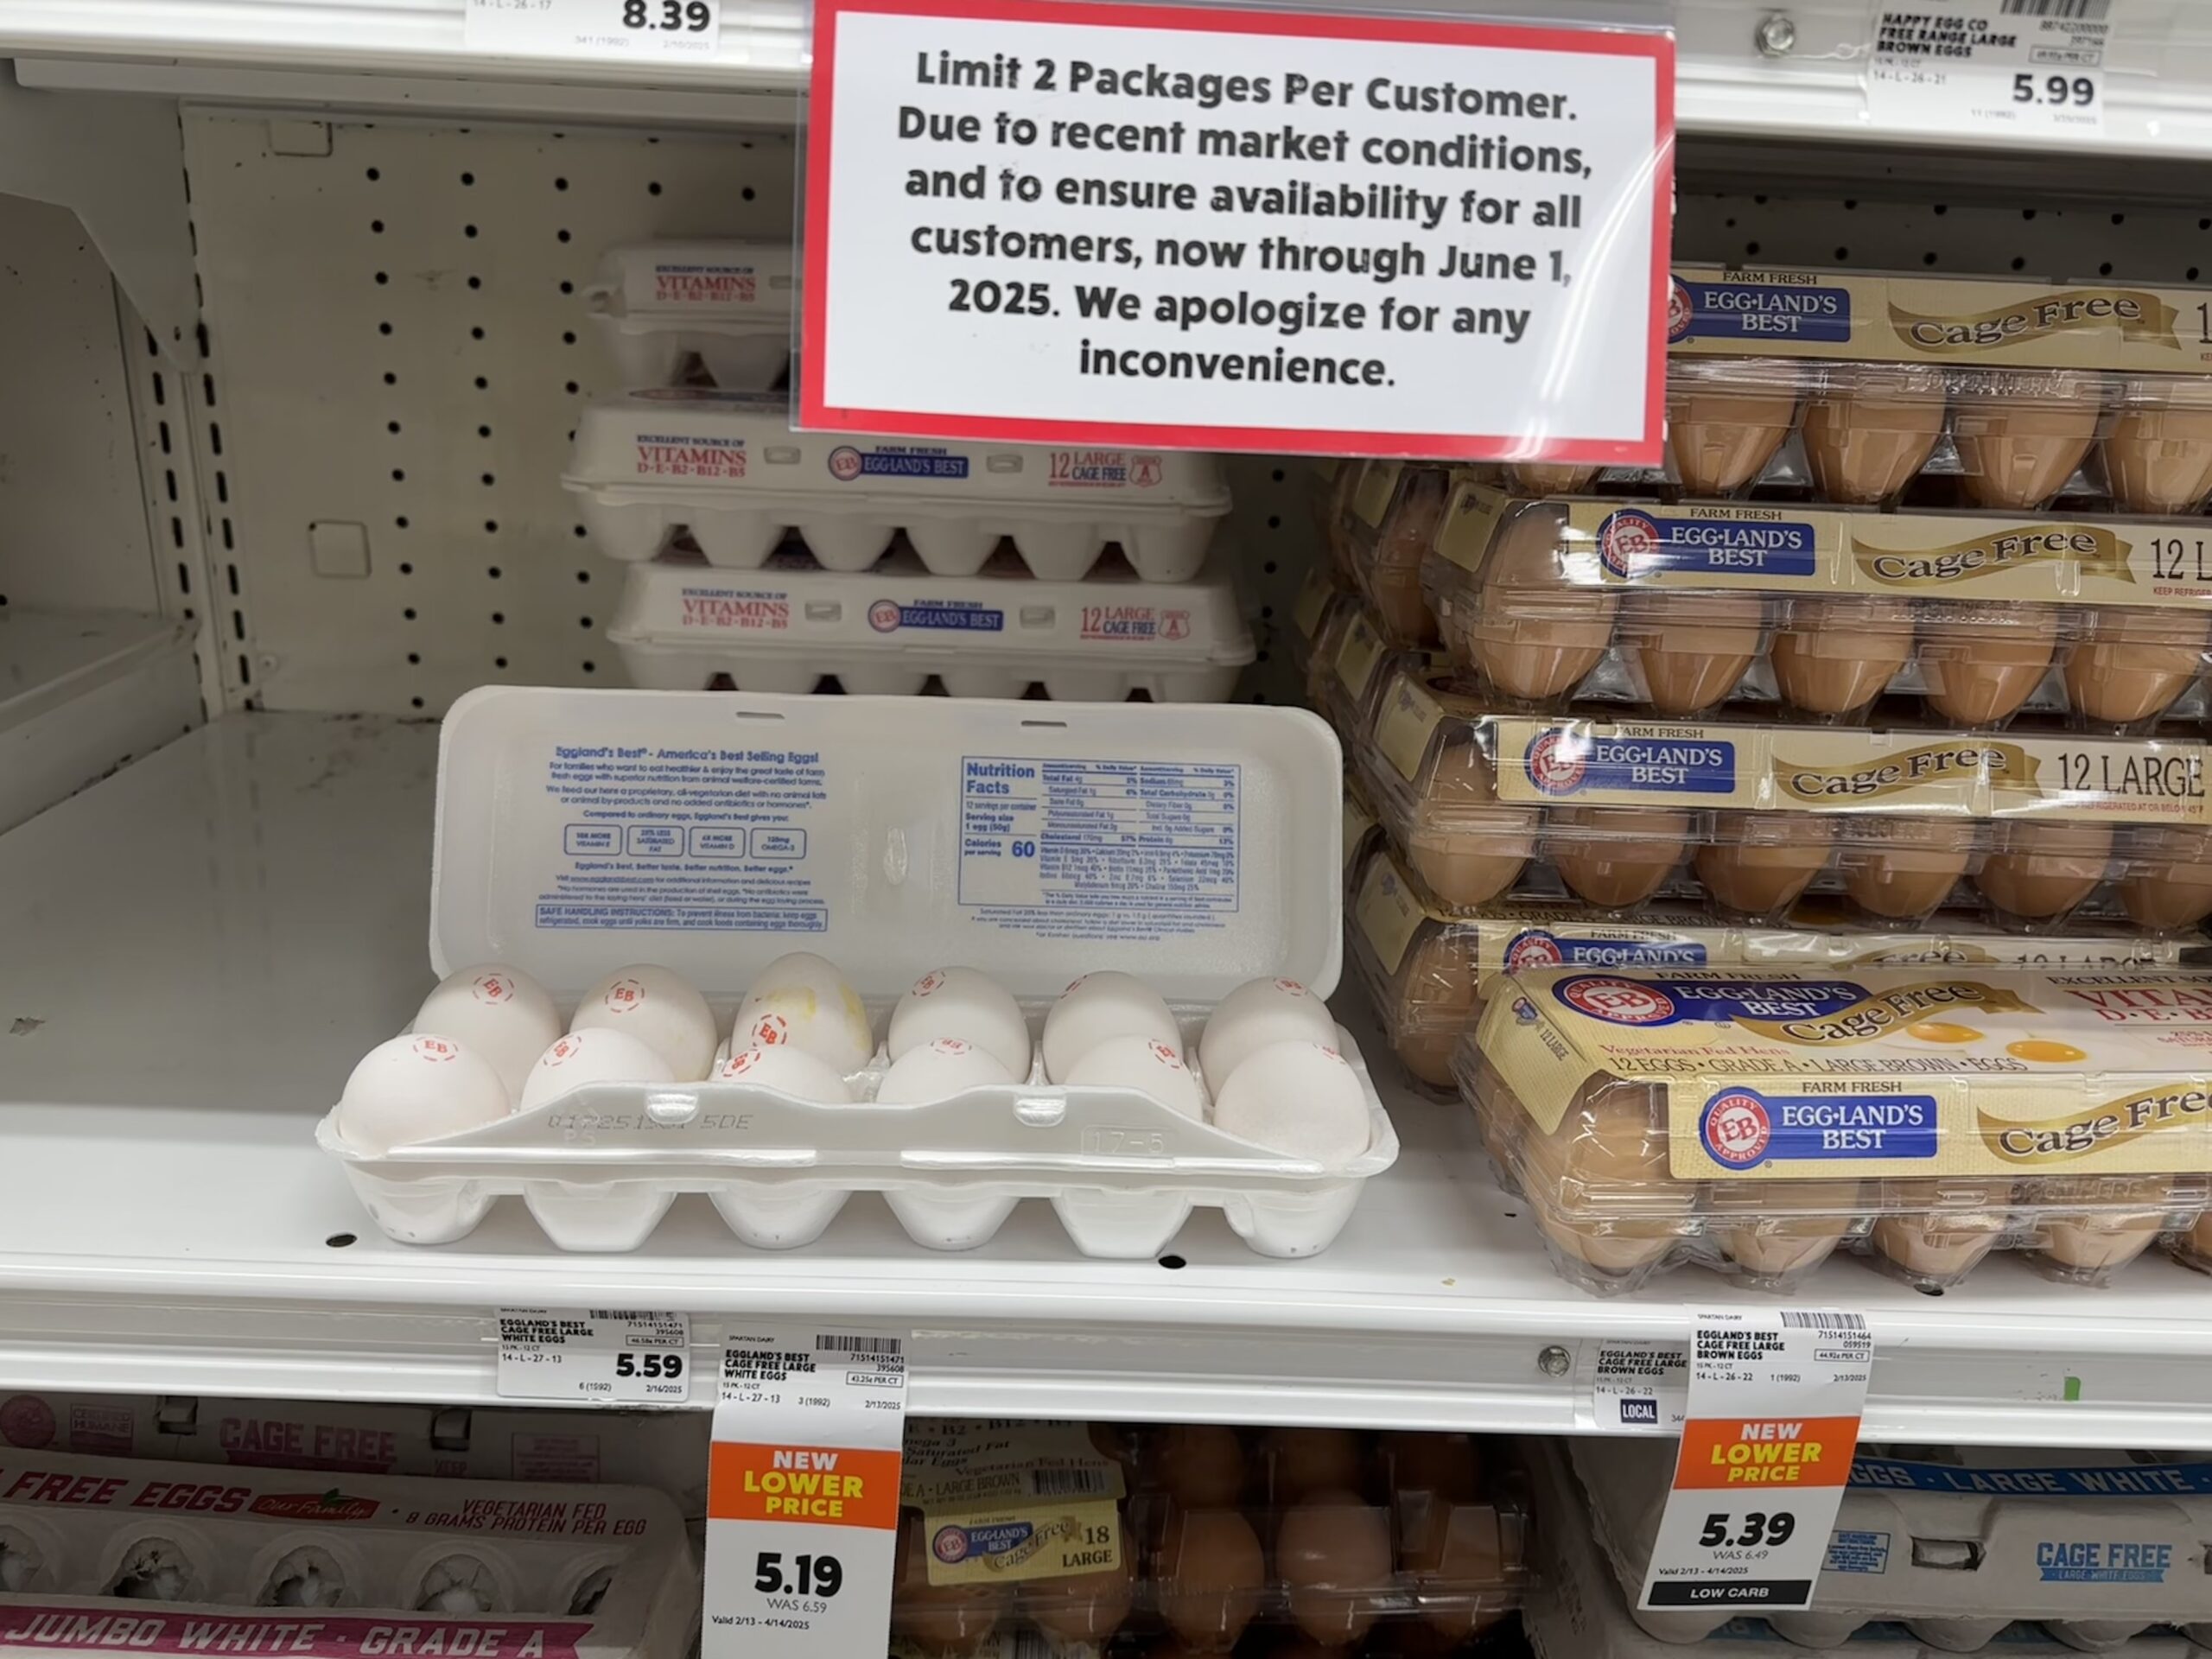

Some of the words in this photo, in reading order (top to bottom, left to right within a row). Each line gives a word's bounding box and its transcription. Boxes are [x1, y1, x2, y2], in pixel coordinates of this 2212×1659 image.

[622, 0, 710, 32] 8.39
[1882, 14, 1931, 29] HAPPY
[1935, 17, 1962, 29] EGG
[1968, 19, 1988, 31] CO
[916, 52, 1020, 89] Limit
[1035, 60, 1057, 92] 2
[1070, 60, 1271, 107] Packages
[1284, 73, 1352, 110] Per
[1365, 77, 1577, 120] Customer.
[2013, 73, 2094, 106] 5.99
[898, 107, 980, 143] Due
[995, 111, 1037, 147] to
[1051, 116, 1185, 156] recent
[1198, 125, 1350, 163] market
[1362, 132, 1592, 179] conditions,
[905, 166, 985, 201] and
[1000, 168, 1042, 206] to
[1055, 179, 1197, 213] ensure
[1211, 182, 1446, 231] availability
[1461, 189, 1519, 229] for
[1532, 193, 1581, 229] all
[912, 224, 1142, 269] customers,
[1155, 238, 1245, 268] now
[1258, 236, 1425, 281] through
[1437, 245, 1536, 279] June
[1548, 247, 1572, 286] 1,
[657, 276, 755, 290] VITAMINS
[1723, 272, 1764, 283] FARM
[1770, 273, 1817, 285] FRESH
[948, 279, 1060, 316] 2025.
[1074, 284, 1141, 321] We
[1154, 288, 1367, 338] apologize
[1380, 296, 1440, 333] for
[1452, 304, 1529, 345] any
[1911, 309, 2026, 346] Cage
[2034, 295, 2140, 328] Free
[1742, 314, 1802, 332] BEST
[1078, 340, 1395, 388] inconvenience.
[638, 446, 747, 466] VITAMINS
[935, 458, 964, 475] BEST
[1050, 452, 1070, 480] 12
[1075, 452, 1124, 465] LARGE
[1691, 508, 1730, 518] FARM
[1735, 510, 1782, 520] FRESH
[1709, 548, 1768, 566] BEST
[1872, 547, 1986, 581] Cage
[1991, 530, 2095, 563] Free
[2151, 537, 2184, 579] 12
[683, 600, 789, 618] VITAMINS
[970, 613, 1000, 628] BEST
[1081, 607, 1100, 632] 12
[1105, 607, 1154, 620] LARGE
[1658, 728, 1704, 739] FRESH
[657, 748, 716, 760] America's
[721, 750, 743, 761] Best
[747, 751, 785, 764] Selling
[967, 763, 1035, 778] Nutrition
[1632, 766, 1688, 784] BEST
[1791, 765, 1902, 798] Cage
[1907, 745, 2005, 781] Free
[2058, 753, 2091, 791] 12
[2101, 755, 2205, 797] LARGE
[967, 780, 1009, 795] Facts
[965, 838, 1001, 848] Calories
[1012, 841, 1035, 857] 60
[615, 988, 635, 1002] EB
[1740, 1001, 1819, 1017] BEST
[423, 1039, 448, 1054] EB
[1600, 1044, 1698, 1056] Vegetarian
[1703, 1046, 1735, 1056] Fed
[1740, 1047, 1789, 1056] Hens
[1610, 1058, 1635, 1071] 12
[1642, 1058, 1695, 1072] EGGS
[1708, 1058, 1780, 1072] GRADE
[1783, 1058, 1801, 1071] A
[1814, 1058, 1877, 1072] LARGE
[1880, 1058, 1955, 1072] BROWN
[1971, 1058, 2029, 1071] EGGS
[1802, 1082, 1846, 1093] FARM
[1851, 1082, 1902, 1093] FRESH
[1822, 1131, 1886, 1150] BEST
[500, 1319, 558, 1328] EGGLAND'S
[561, 1320, 586, 1329] BEST
[559, 1328, 594, 1337] LARGE
[1697, 1331, 1751, 1340] EGGLAND'S
[1755, 1332, 1778, 1341] BEST
[1818, 1331, 1871, 1339] 71514151464
[1697, 1341, 1723, 1350] CAGE
[1726, 1341, 1751, 1350] FREE
[1753, 1342, 1785, 1351] LARGE
[726, 1350, 781, 1360] EGGLAND'S
[785, 1351, 810, 1362] BEST
[850, 1353, 904, 1363] 71514151471
[1697, 1351, 1735, 1359] BROWN
[1738, 1351, 1763, 1360] EGGS
[616, 1353, 683, 1378] 5.59
[725, 1359, 752, 1369] CAGE
[755, 1360, 780, 1370] FREE
[784, 1363, 816, 1373] LARGE
[725, 1370, 757, 1380] WHITE
[760, 1370, 786, 1381] EGGS
[1623, 1404, 1655, 1419] LOCAL
[73, 1420, 130, 1433] HUMANE
[1740, 1423, 1802, 1440] NEW
[219, 1417, 303, 1453] CAGE
[315, 1425, 397, 1462] FREE
[773, 1451, 837, 1471] NEW
[1711, 1443, 1822, 1465] LOWER
[1727, 1465, 1800, 1482] PRICE
[3, 1471, 129, 1504] FREE
[130, 1482, 251, 1513] EGGS
[744, 1471, 863, 1498] LOWER
[463, 1499, 567, 1518] VEGETARIAN
[573, 1503, 606, 1519] FED
[766, 1497, 842, 1517] PRICE
[406, 1512, 416, 1523] 8
[424, 1513, 483, 1529] GRAMS
[492, 1516, 566, 1533] PROTEIN
[572, 1518, 605, 1535] PER
[613, 1520, 646, 1535] EGG
[1699, 1512, 1796, 1547] 5.39
[1086, 1526, 1109, 1545] 18
[988, 1540, 1012, 1552] BEST
[995, 1545, 1031, 1569] Cage
[1034, 1522, 1069, 1548] Free
[2037, 1542, 2102, 1567] CAGE
[2108, 1544, 2172, 1567] FREE
[1062, 1550, 1113, 1567] LARGE
[754, 1552, 842, 1598] 5.19
[1691, 1588, 1725, 1599] LOW
[1728, 1588, 1769, 1599] CARB
[767, 1599, 798, 1611] WAS
[804, 1601, 827, 1613] 6.59
[712, 1616, 733, 1625] Valid
[735, 1617, 755, 1626] 2/13
[766, 1618, 810, 1630] 4/14/2025
[4, 1614, 161, 1645] JUMBO
[178, 1620, 327, 1652] WHITE
[361, 1626, 501, 1657] GRADE
[515, 1630, 545, 1659] A
